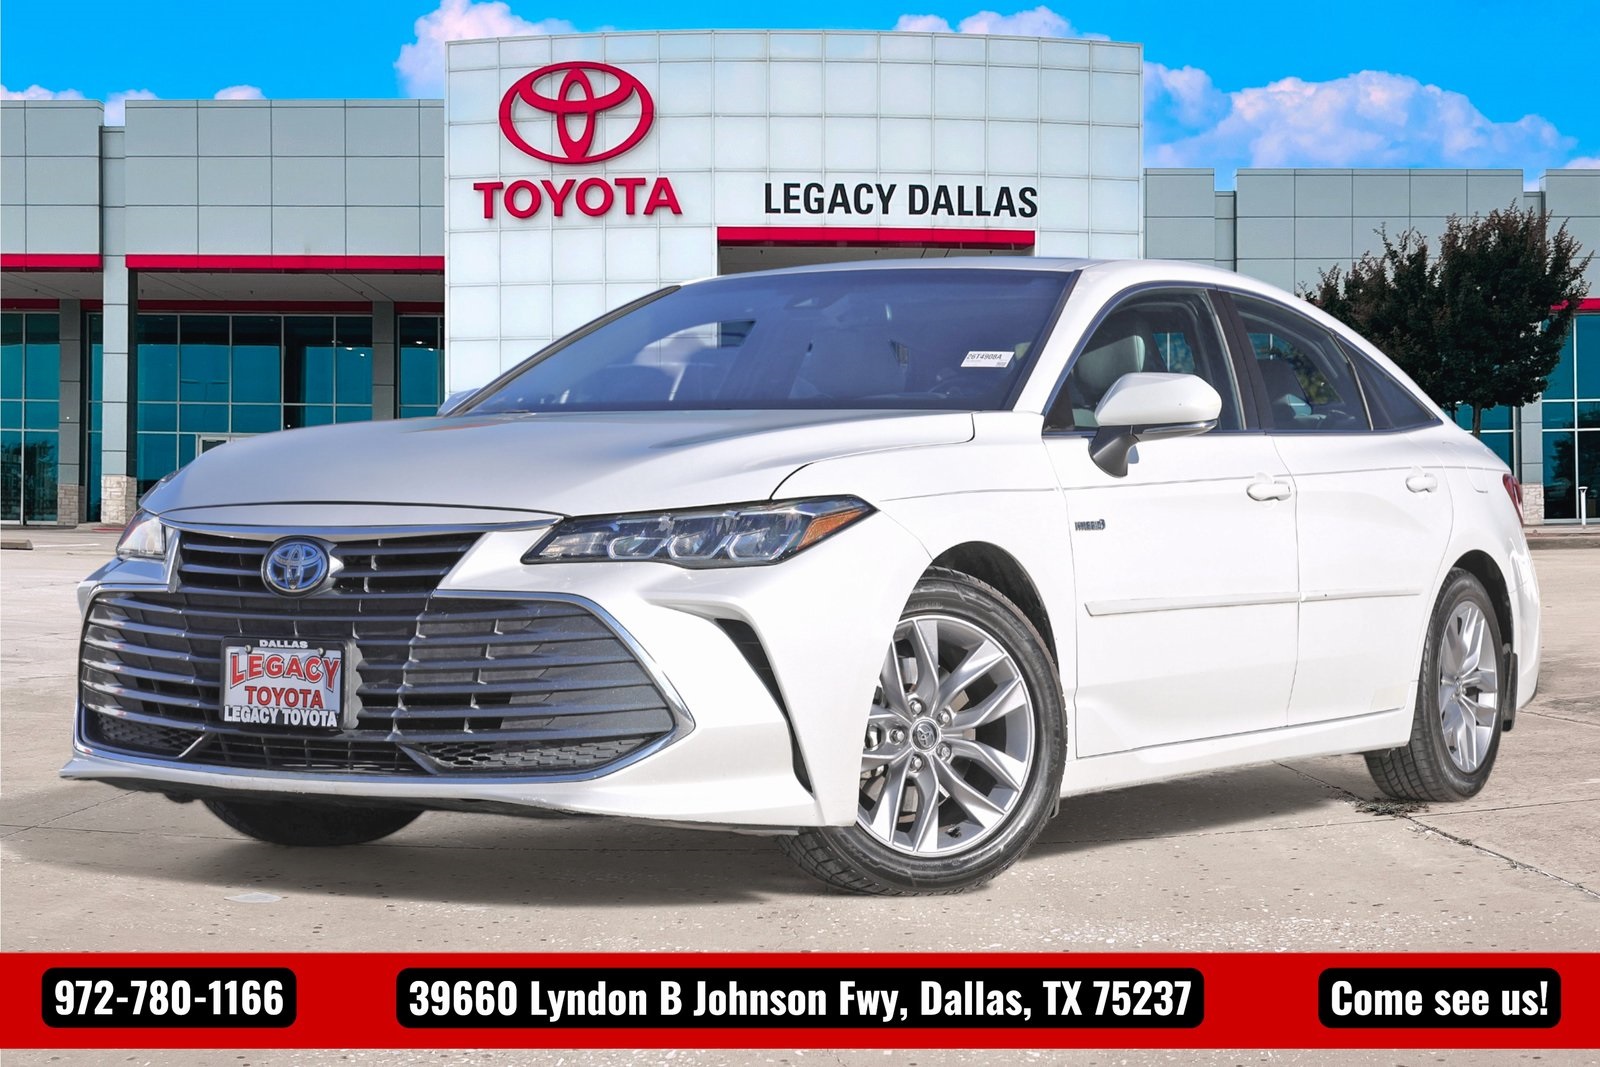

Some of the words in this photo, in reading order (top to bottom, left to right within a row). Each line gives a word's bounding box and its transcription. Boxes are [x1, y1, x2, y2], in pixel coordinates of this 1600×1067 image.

[474, 177, 681, 219] TOYOTA
[765, 183, 896, 214] LEGACY
[909, 185, 1037, 217] DALLAS
[259, 640, 308, 648] DALLAS
[230, 652, 341, 692] LEGACY
[245, 686, 324, 709] TOYOTA
[224, 705, 279, 724] LEGACY
[282, 708, 338, 727] TOYOTA
